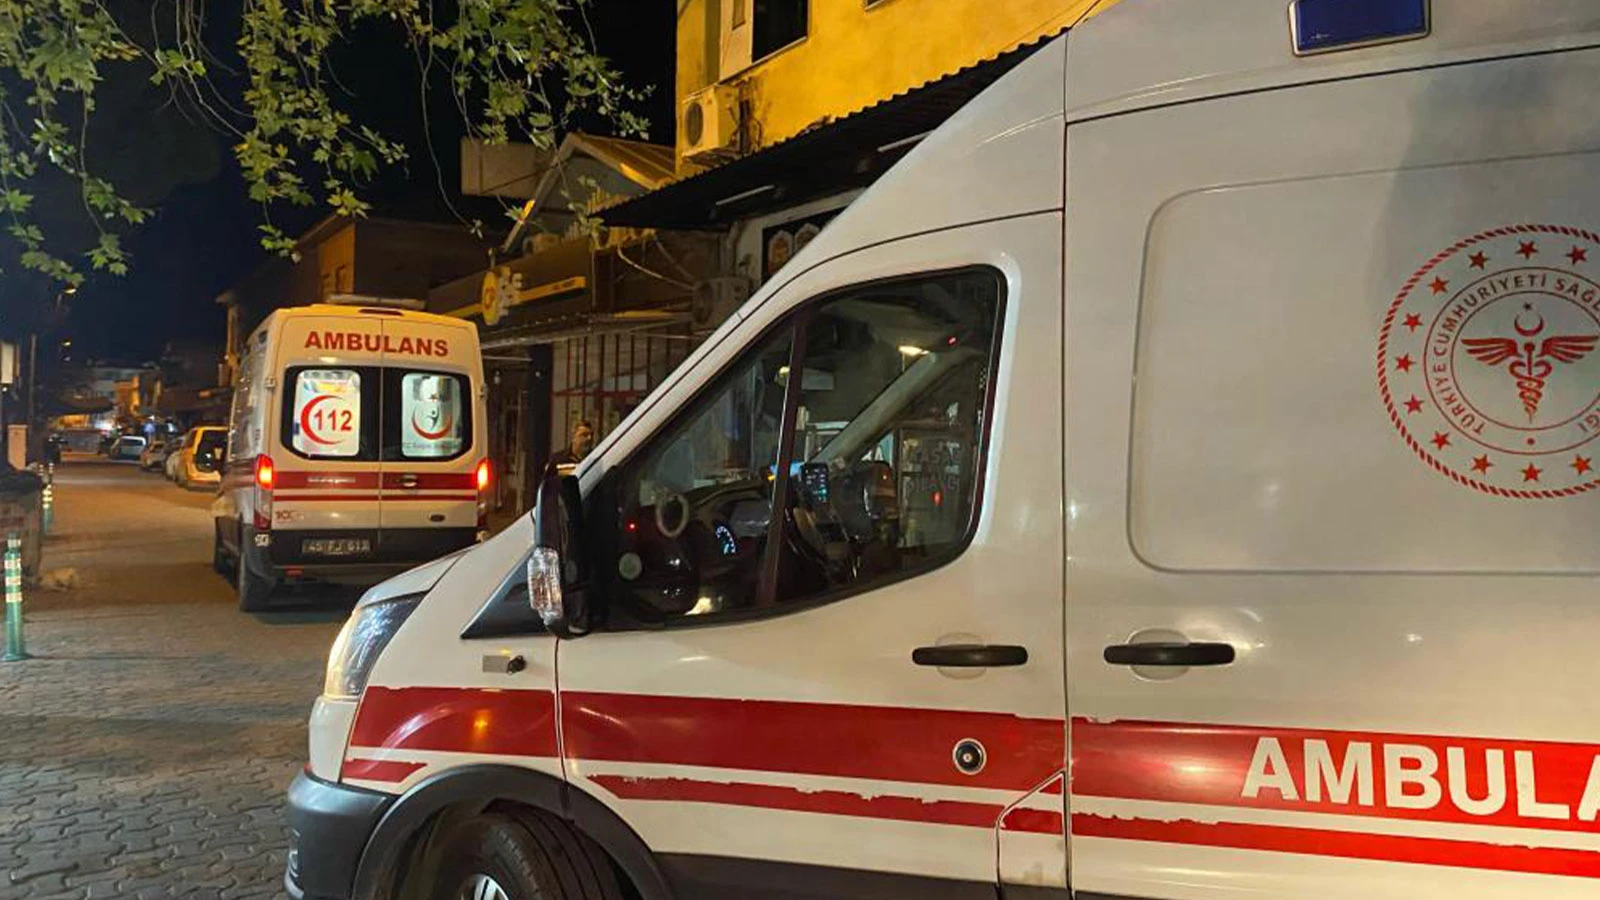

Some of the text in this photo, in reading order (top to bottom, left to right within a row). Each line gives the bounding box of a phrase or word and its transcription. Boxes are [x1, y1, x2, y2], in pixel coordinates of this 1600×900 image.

[1434, 273, 1547, 357] CUMHURİYETİ
[304, 331, 449, 357] AMBULANS
[313, 409, 353, 432] 112
[1433, 362, 1486, 435] TÜRKİYE
